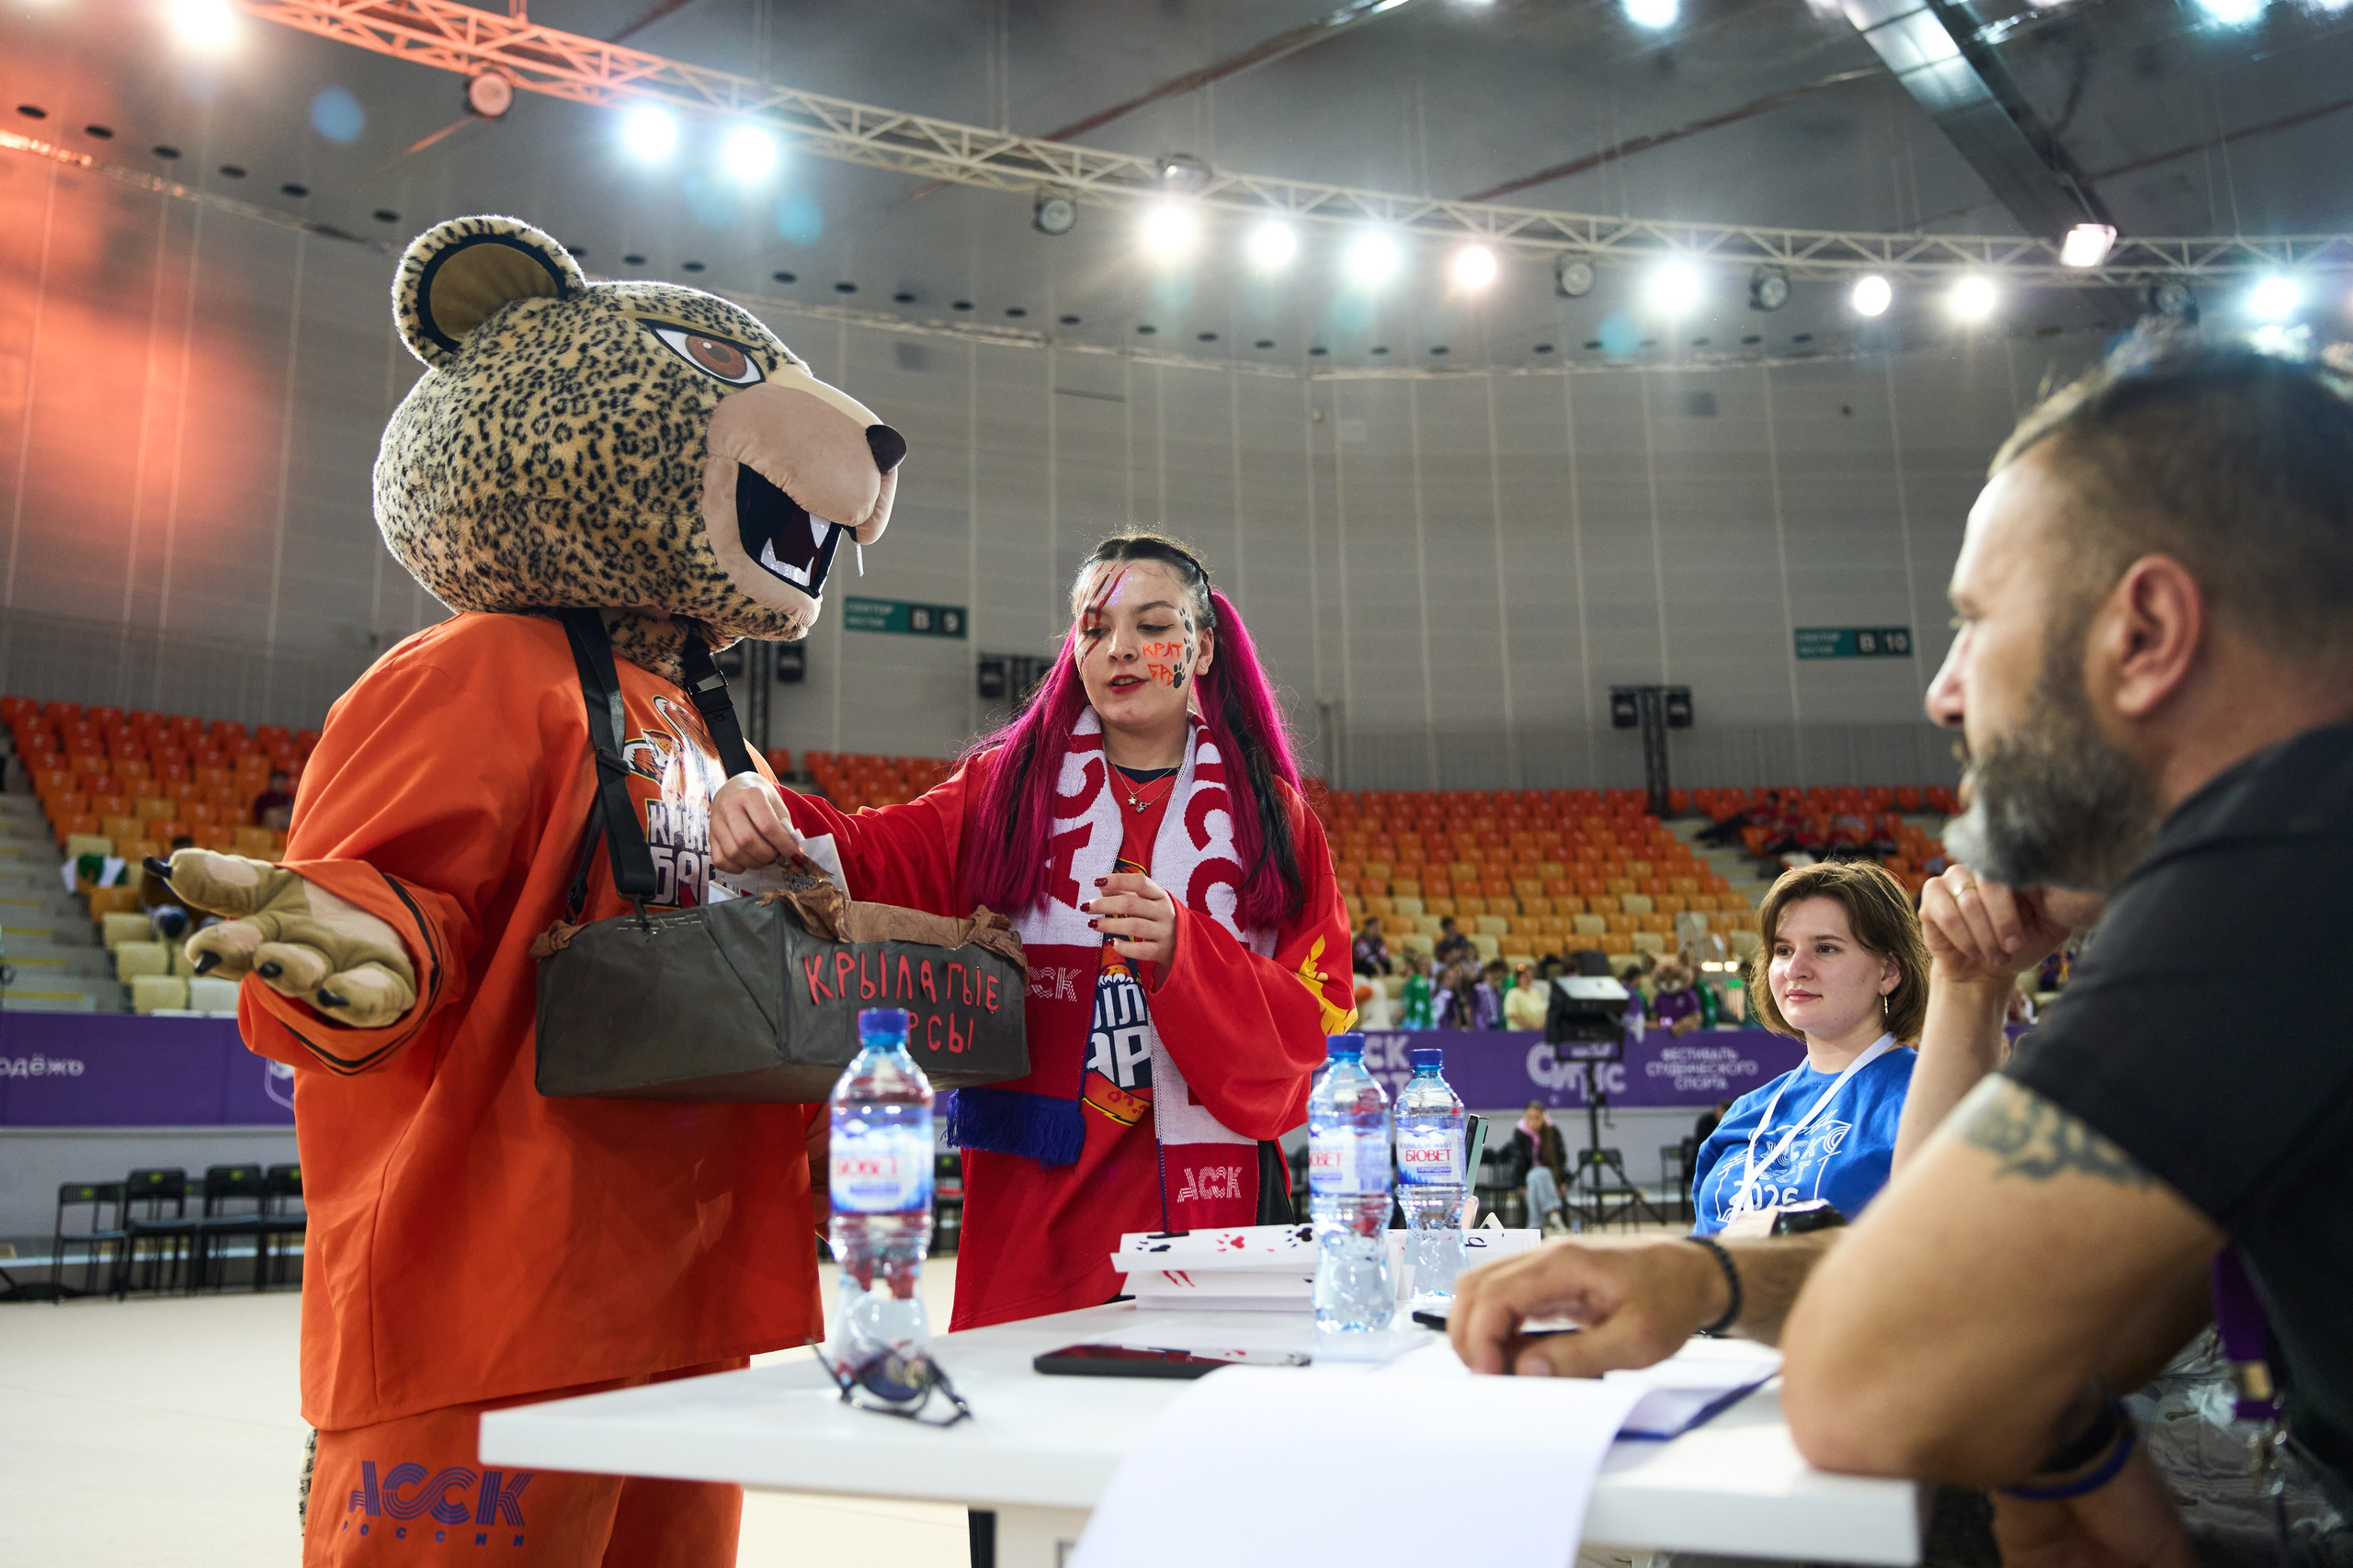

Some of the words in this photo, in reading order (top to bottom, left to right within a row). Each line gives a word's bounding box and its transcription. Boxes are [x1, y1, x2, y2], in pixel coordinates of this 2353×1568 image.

[904, 1011, 974, 1054] РСЫ
[1405, 1149, 1451, 1162] БЮВЕТ
[1176, 1165, 1243, 1203] АССК
[347, 1460, 533, 1528] АССК
